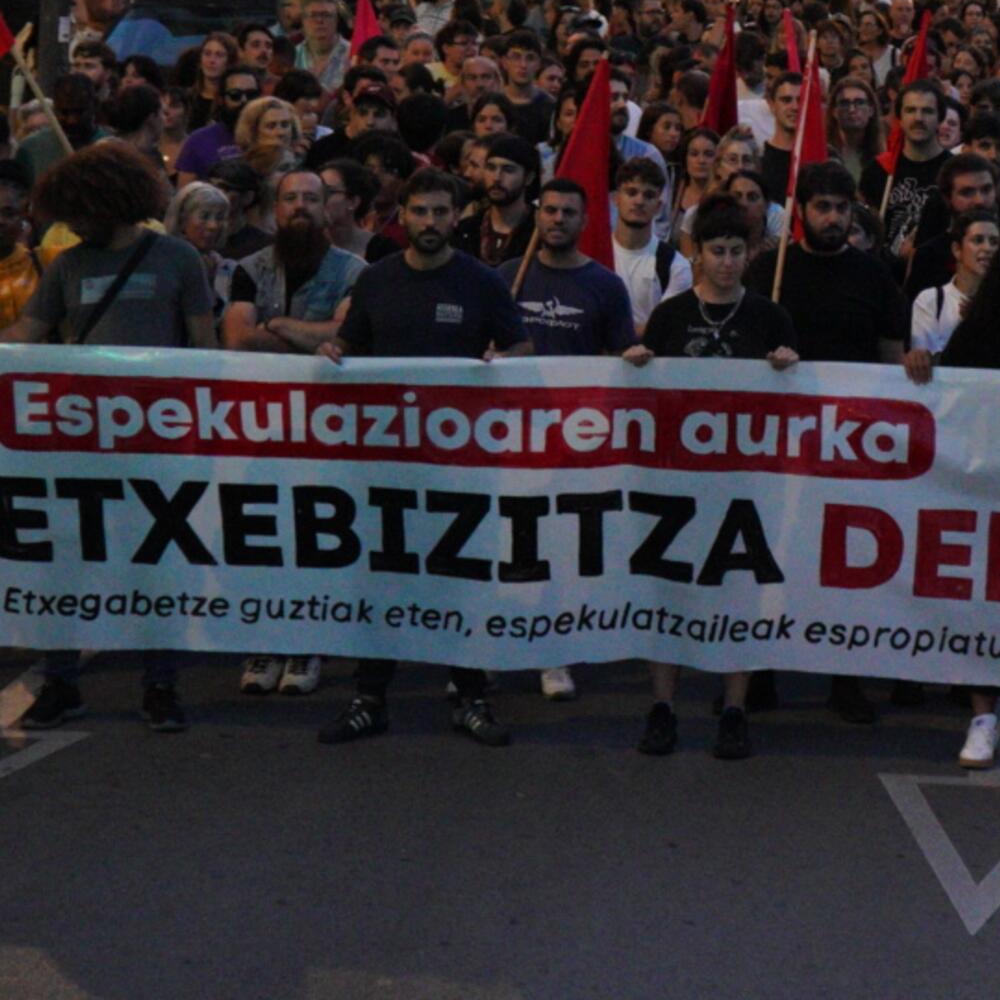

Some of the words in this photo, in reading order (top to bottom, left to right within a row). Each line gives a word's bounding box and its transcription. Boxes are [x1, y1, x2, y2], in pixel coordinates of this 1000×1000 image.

[13, 380, 656, 453] Espekulazioaren
[679, 404, 910, 464] aurka
[0, 477, 785, 587] ETXEBIZITZA
[3, 587, 230, 622] Etxegabetze
[240, 596, 373, 625] guztiak
[384, 601, 473, 637] eten,
[485, 602, 796, 644] espekulatzaileak
